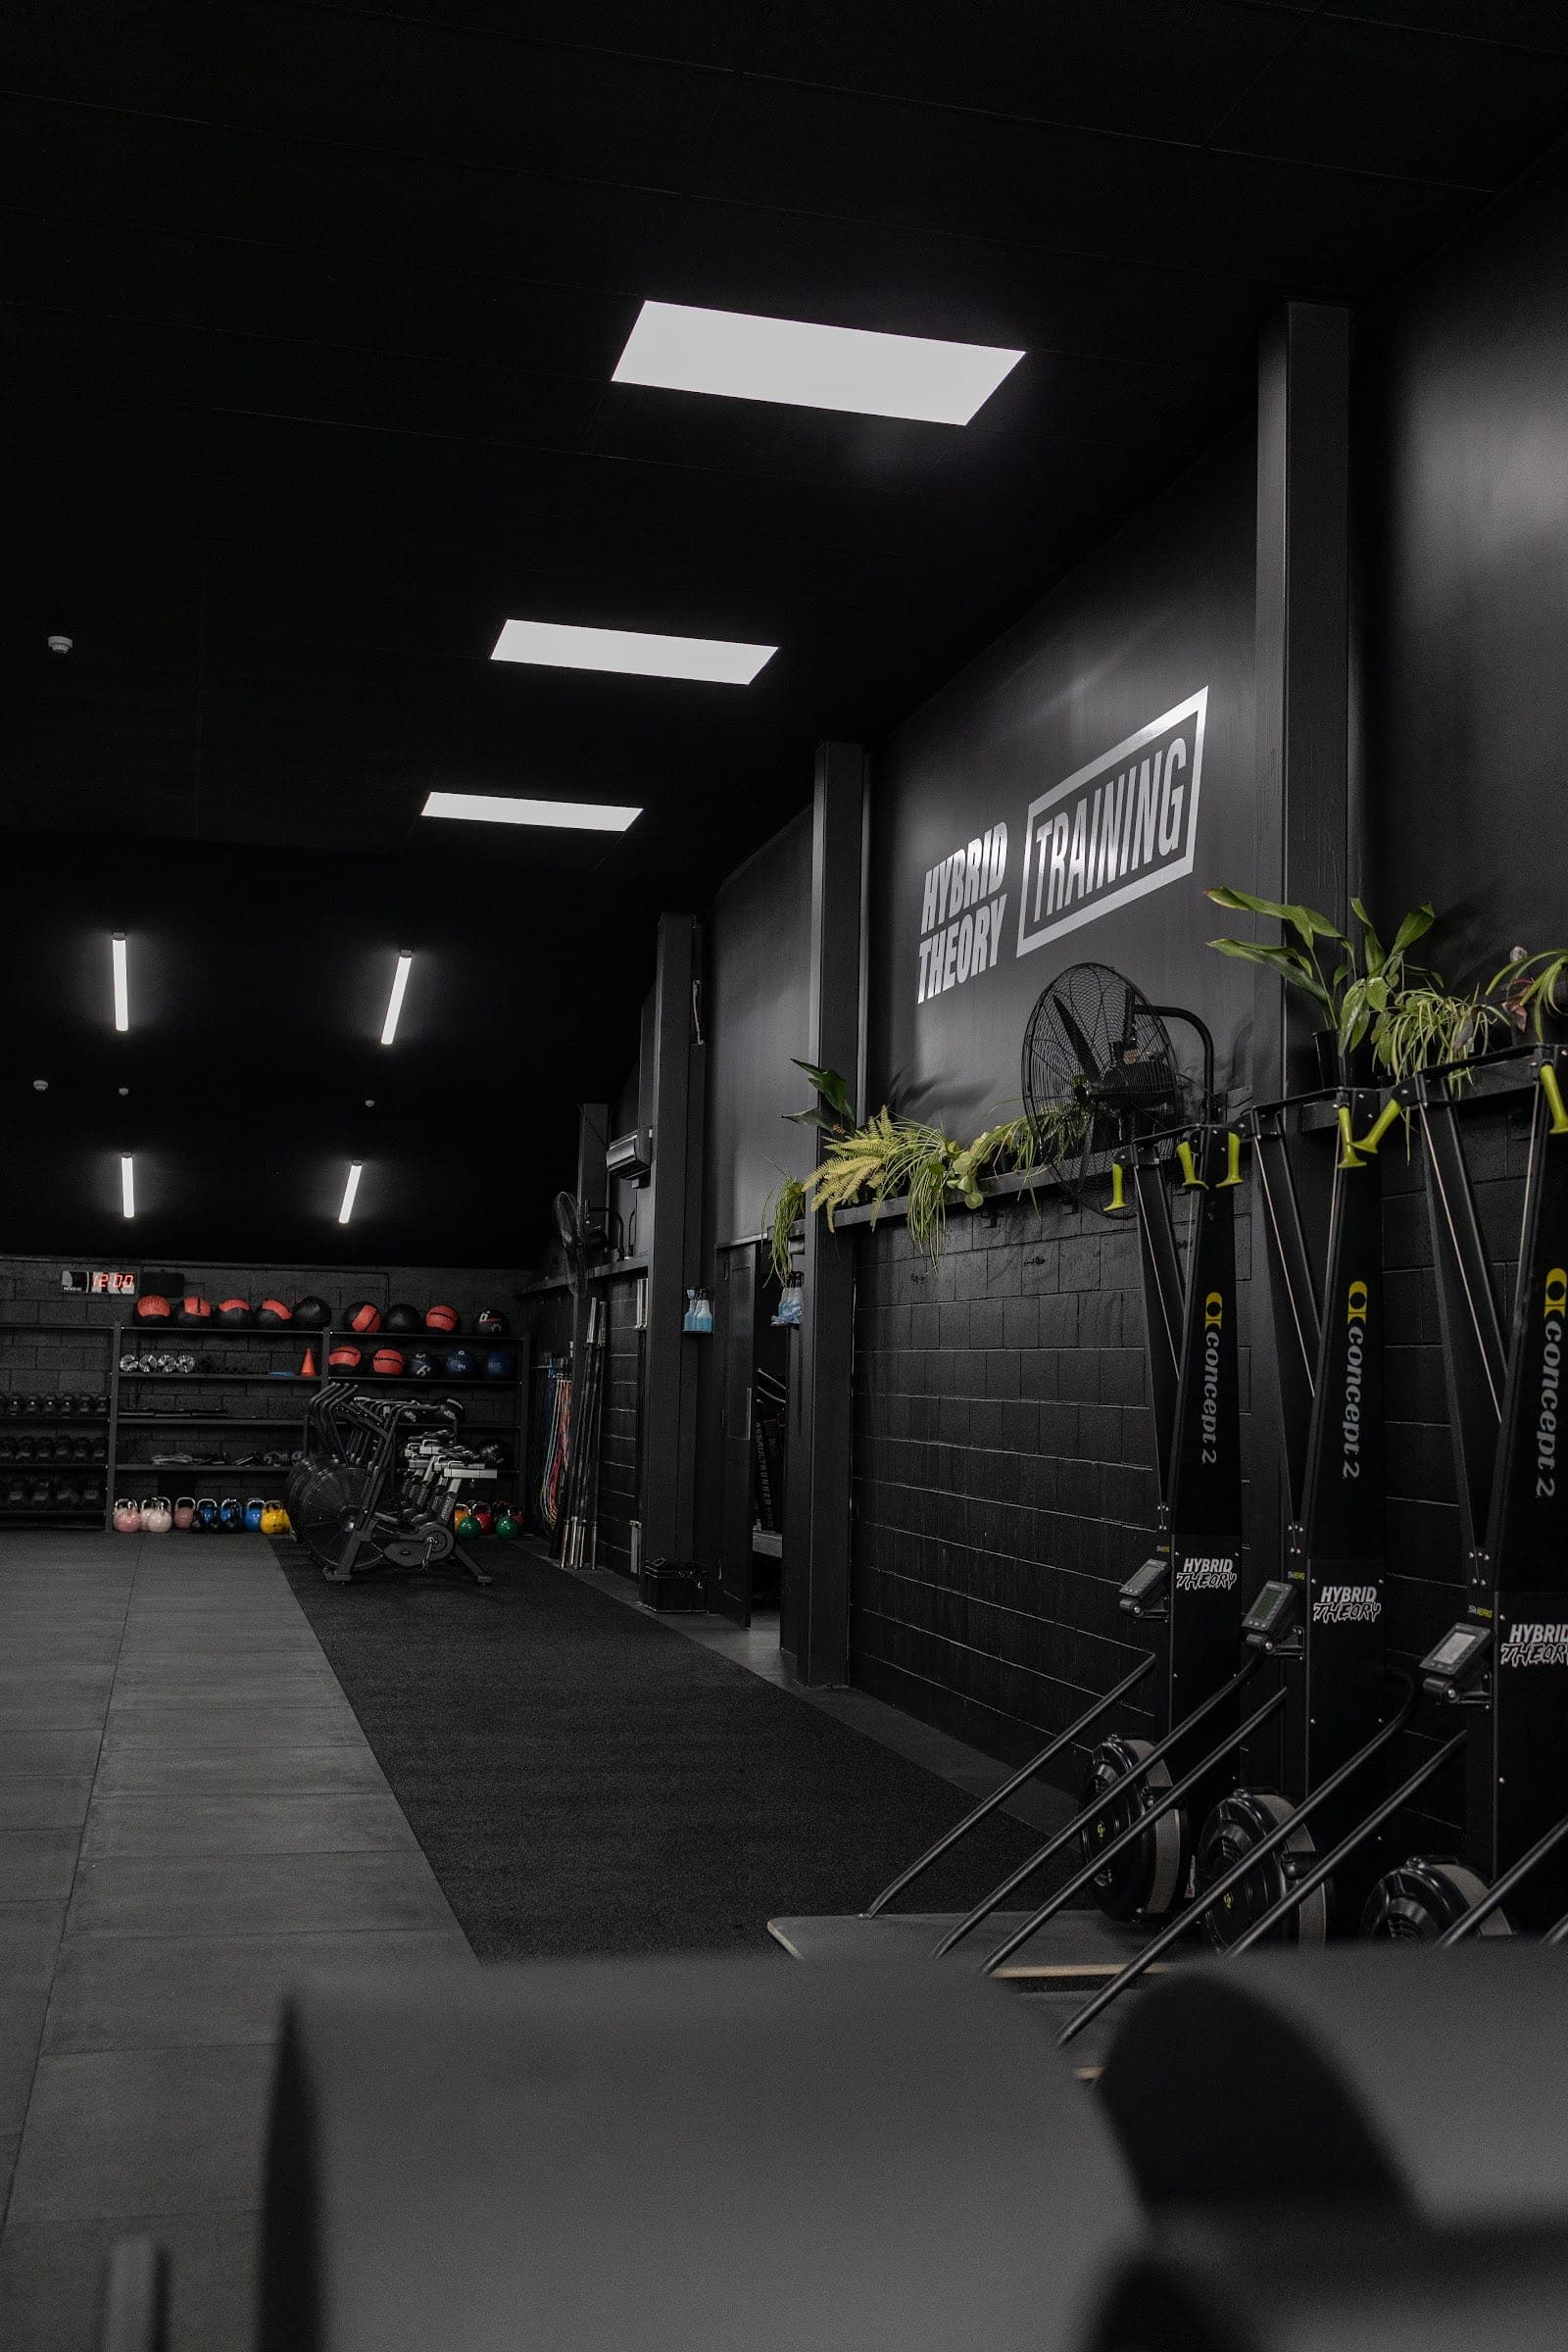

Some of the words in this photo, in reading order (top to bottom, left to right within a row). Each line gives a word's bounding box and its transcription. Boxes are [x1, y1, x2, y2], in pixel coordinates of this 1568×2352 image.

[1034, 738, 1187, 922] TRAINING
[920, 821, 1007, 934] HYBRID
[917, 894, 1006, 1004] THEORY
[1200, 1331, 1221, 1446] concept
[1342, 1325, 1364, 1457] concept
[1536, 1320, 1563, 1473] concept
[1200, 1447, 1217, 1465] 2
[1342, 1459, 1361, 1480] 2
[1536, 1476, 1556, 1499] 2
[1183, 1557, 1234, 1572] HYBRID
[1176, 1571, 1238, 1591] THEORY
[1320, 1586, 1378, 1602] HYBRID
[1312, 1602, 1383, 1624] THEORY
[1509, 1623, 1568, 1642] HYBRID
[1500, 1642, 1568, 1668] THEOR
